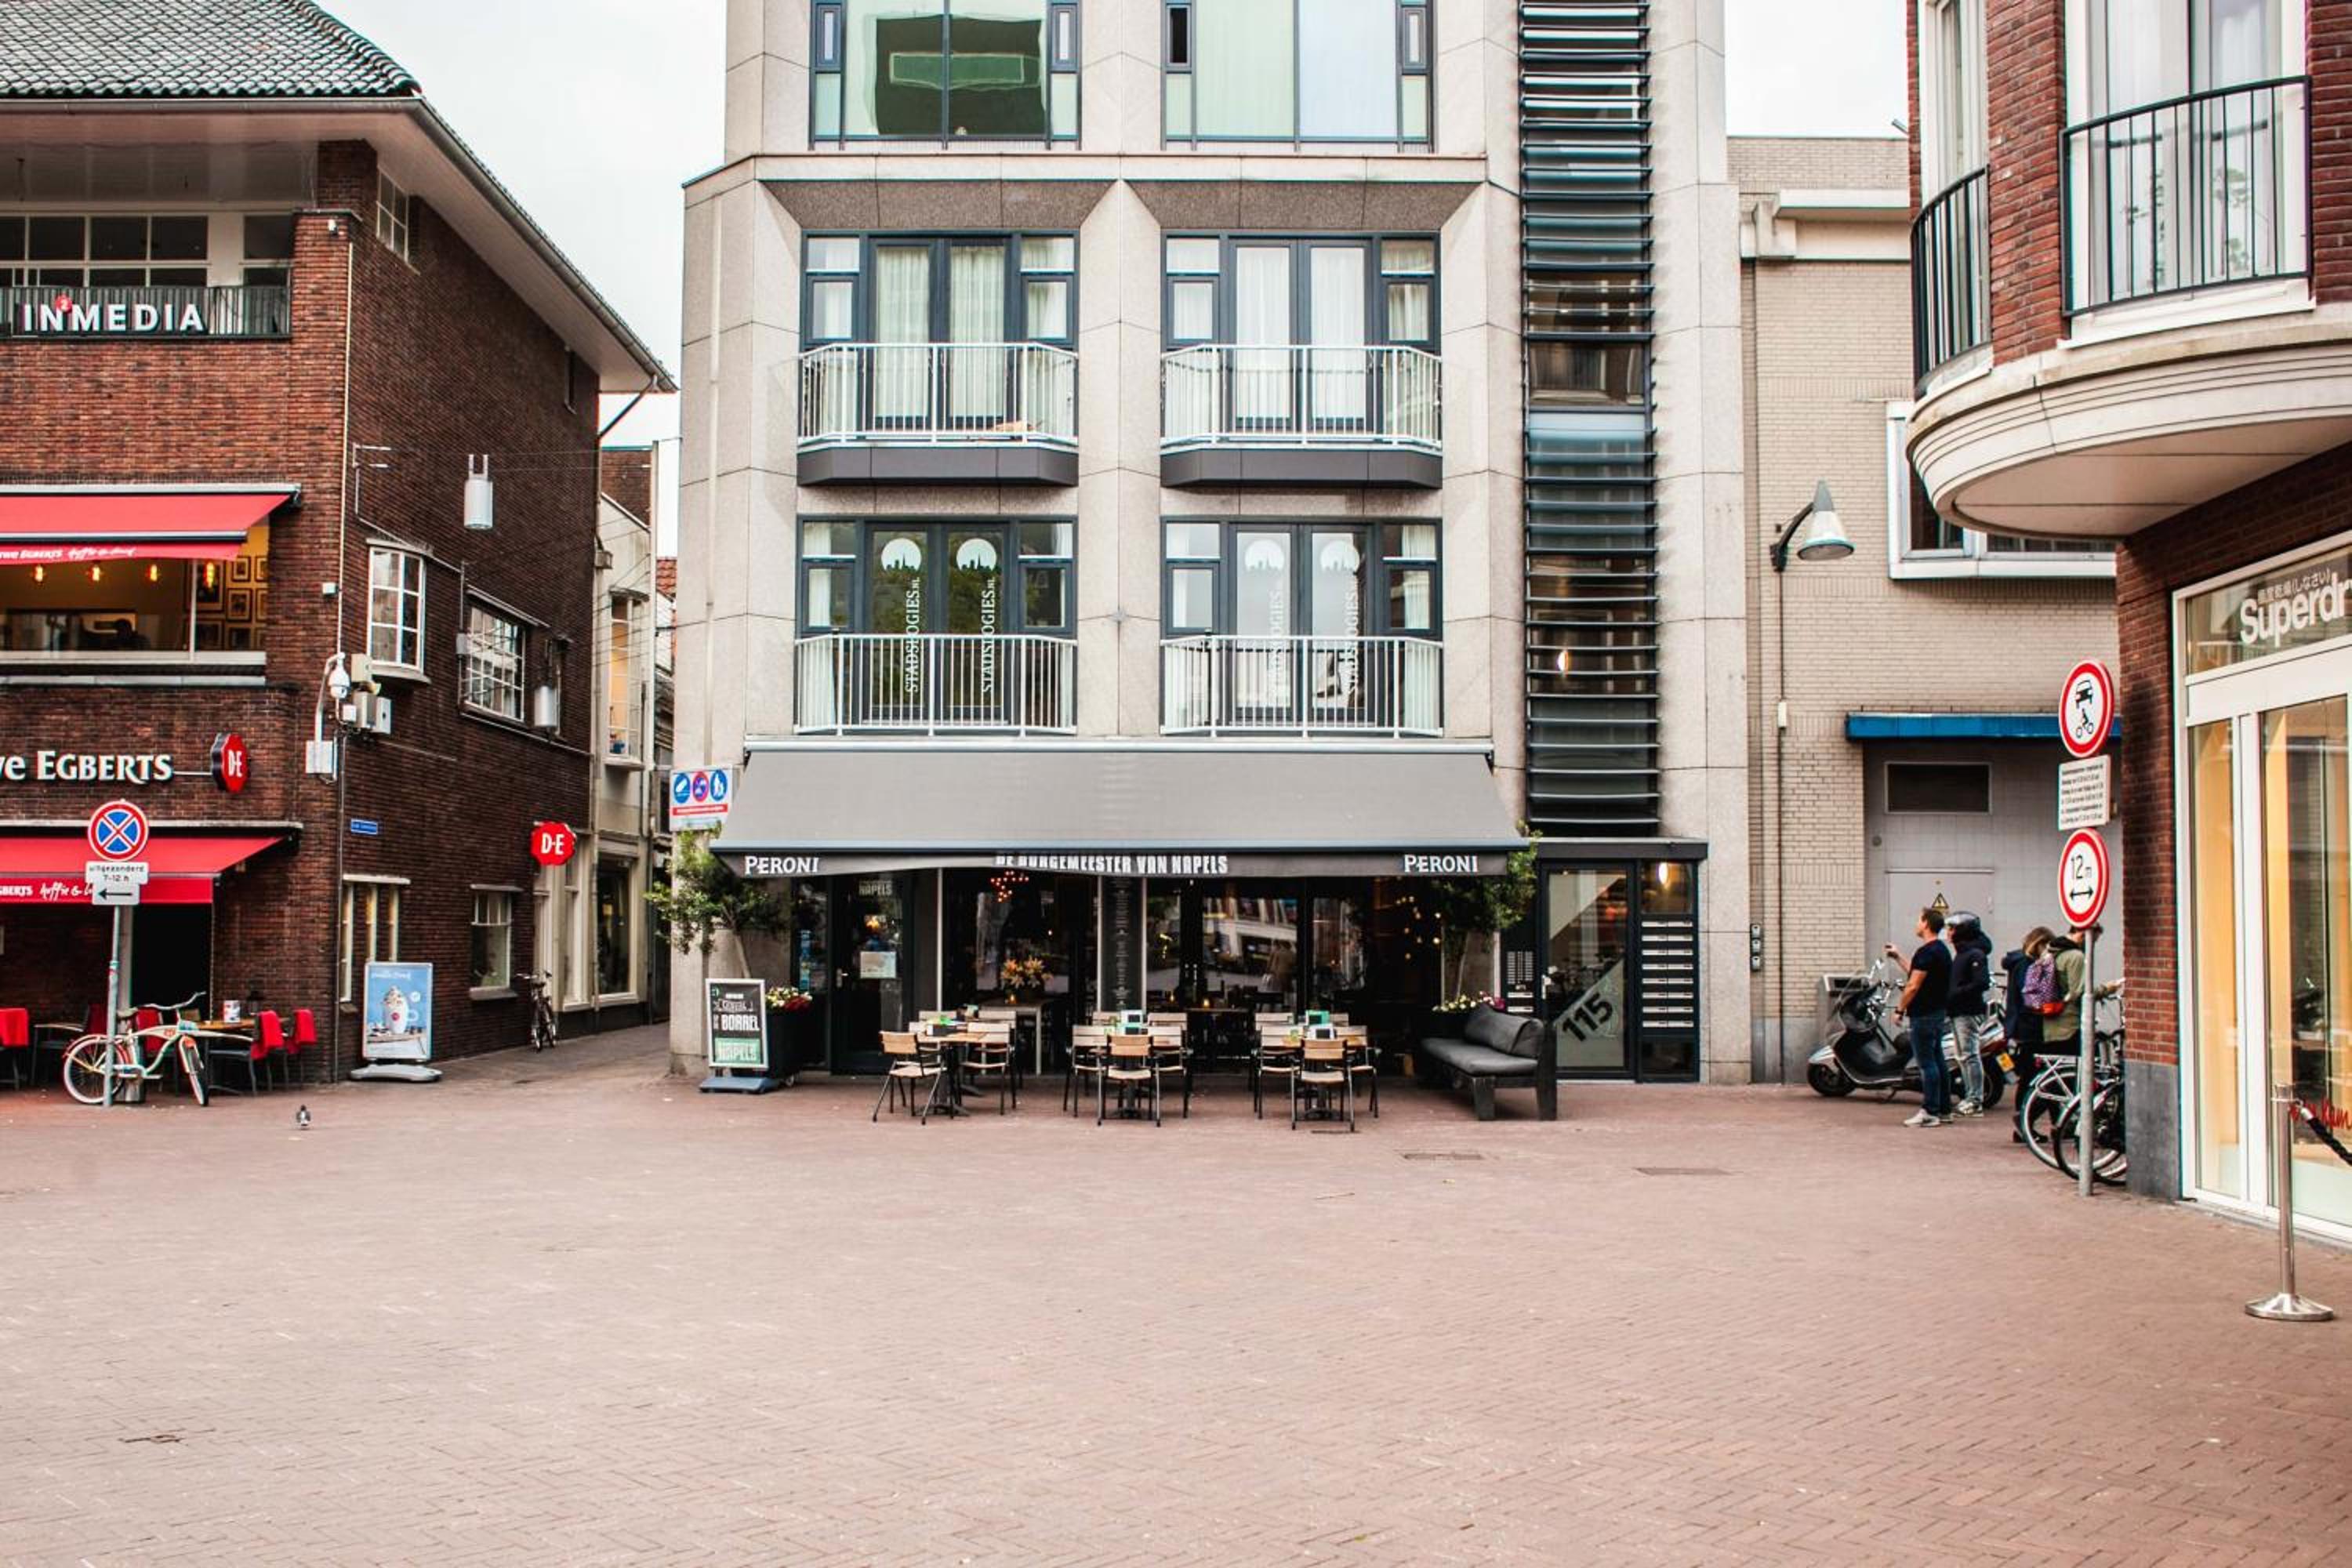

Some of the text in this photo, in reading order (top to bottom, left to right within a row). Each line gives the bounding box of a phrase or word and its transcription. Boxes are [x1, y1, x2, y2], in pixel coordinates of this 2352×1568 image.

[37, 750, 173, 784] EGBERTS
[744, 855, 820, 875] PERONI
[1019, 855, 1131, 873] BURGEMEESTER
[1137, 855, 1167, 874] VAN
[1172, 855, 1229, 874] NAPELS
[1404, 854, 1478, 873] PERONI
[2071, 854, 2083, 879] 12
[1562, 992, 1613, 1043] 115
